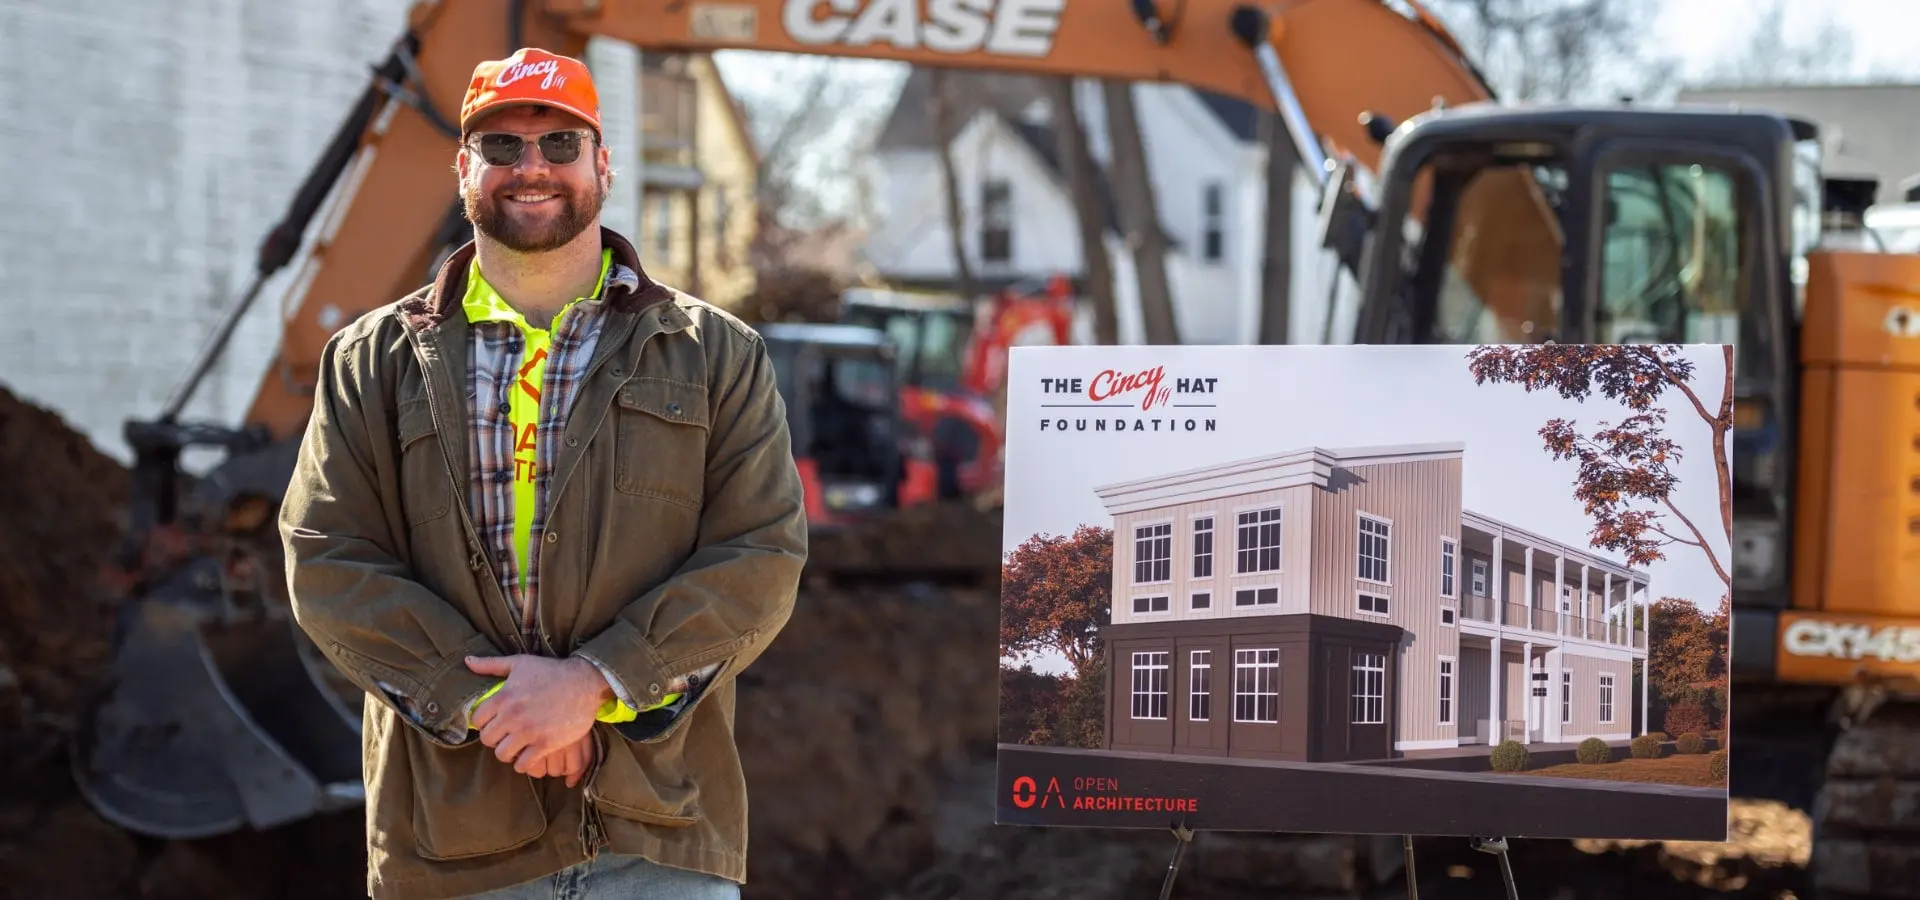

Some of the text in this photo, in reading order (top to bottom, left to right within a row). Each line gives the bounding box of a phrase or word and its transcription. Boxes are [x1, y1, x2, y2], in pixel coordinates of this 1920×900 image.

[781, 0, 1068, 57] CASE
[495, 59, 559, 91] Cincy
[1041, 365, 1218, 412] THE Cincy HAT
[1040, 419, 1216, 431] FOUNDATION
[1074, 777, 1119, 791] OPEN
[1073, 796, 1198, 812] ARCHITECTURE
